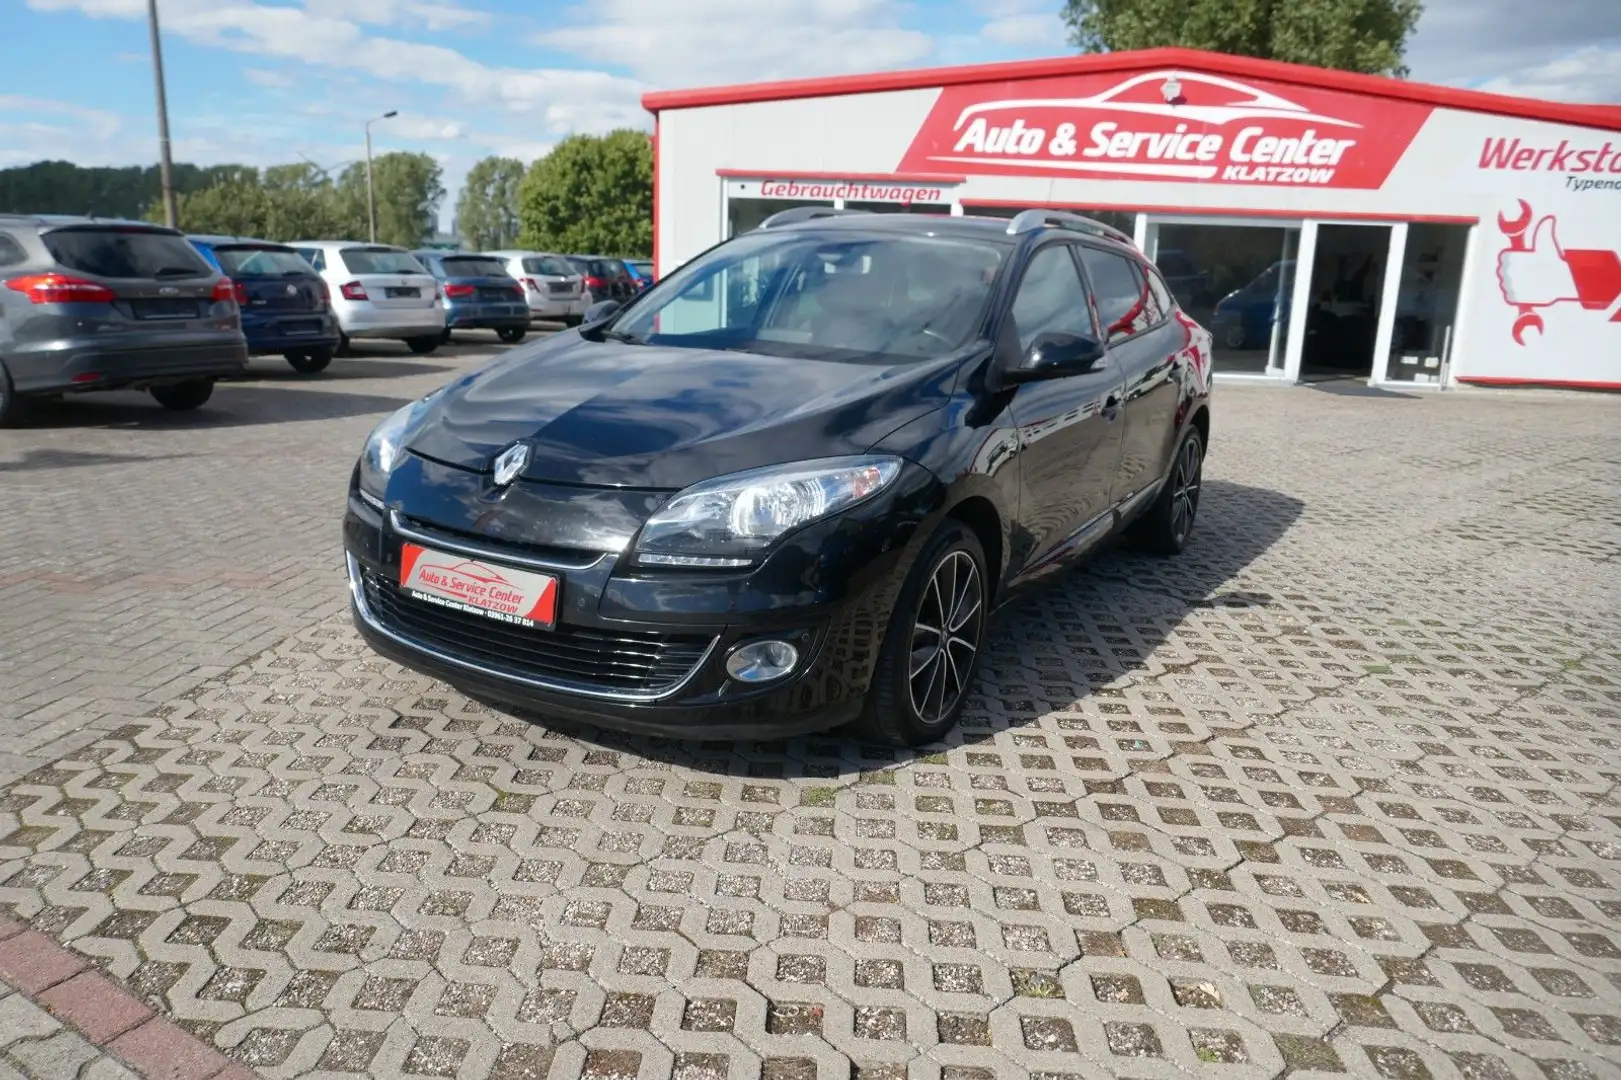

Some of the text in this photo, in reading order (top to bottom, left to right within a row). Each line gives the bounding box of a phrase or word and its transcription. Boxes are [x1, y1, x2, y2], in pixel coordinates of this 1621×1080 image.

[954, 118, 1357, 165] Auto & Service Center
[1222, 166, 1335, 184] KLATZOW
[760, 179, 941, 206] Gebrauchtwagen
[411, 590, 423, 600] Auto
[419, 569, 524, 605] Auto & Service Center
[468, 596, 518, 613] KLATZOW
